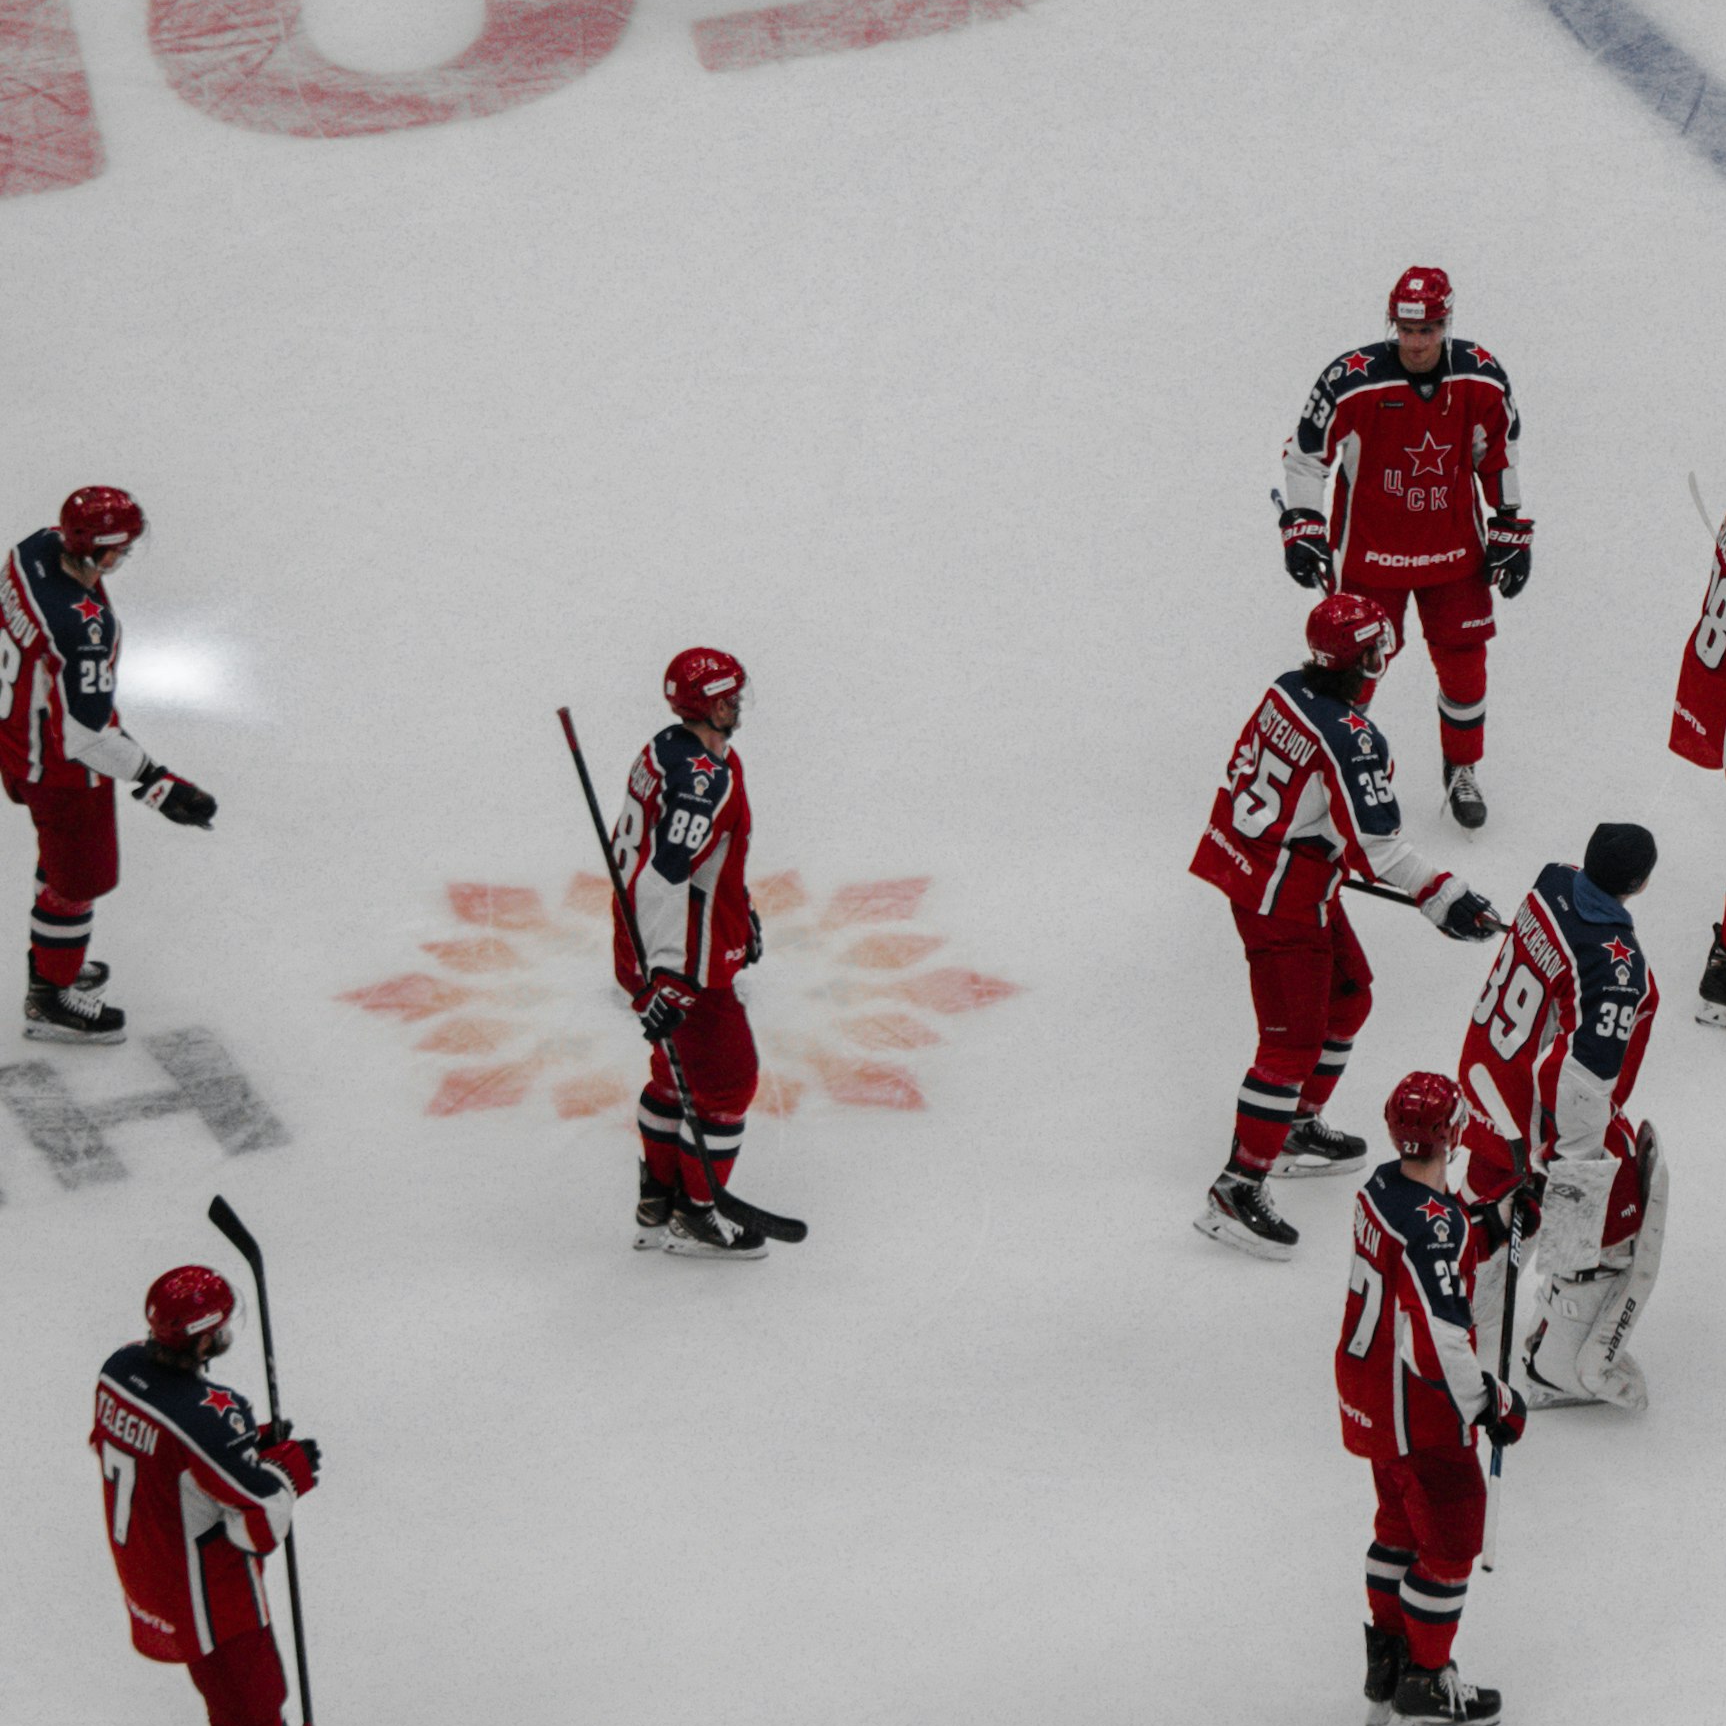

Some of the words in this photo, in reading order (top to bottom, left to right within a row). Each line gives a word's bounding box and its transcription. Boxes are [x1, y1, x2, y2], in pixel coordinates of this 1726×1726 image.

[1365, 547, 1467, 568] РОСНЕФТЬ
[1358, 769, 1395, 808] 35
[666, 808, 710, 850] 88
[1473, 931, 1545, 1061] 39
[1595, 1001, 1635, 1042] 39
[1402, 1140, 1420, 1155] 27
[1604, 1296, 1637, 1363] BAUER
[98, 1388, 160, 1457] TELEGIN
[102, 1439, 137, 1548] 7
